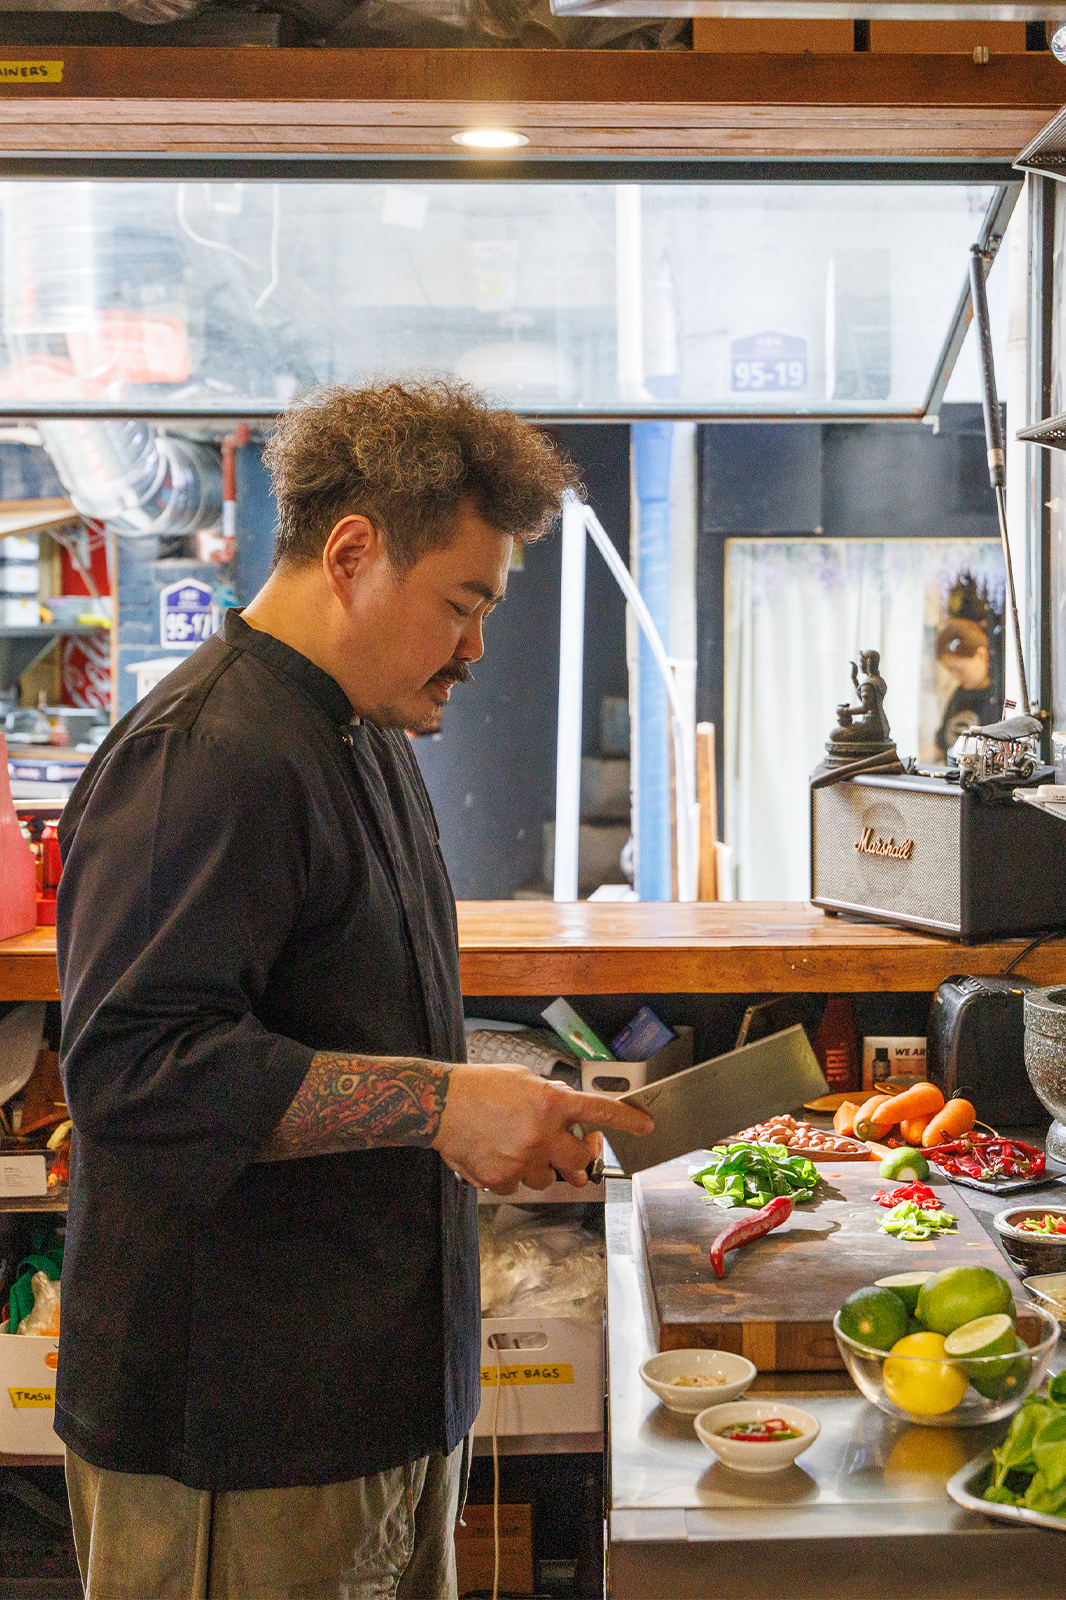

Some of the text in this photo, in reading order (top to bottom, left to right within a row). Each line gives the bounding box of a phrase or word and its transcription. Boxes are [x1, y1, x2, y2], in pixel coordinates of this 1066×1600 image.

[734, 361, 804, 389] 95-19
[854, 826, 914, 860] Marshall
[895, 1048, 911, 1056] WE
[524, 1368, 560, 1379] BAGS
[15, 1391, 51, 1401] TRASH
